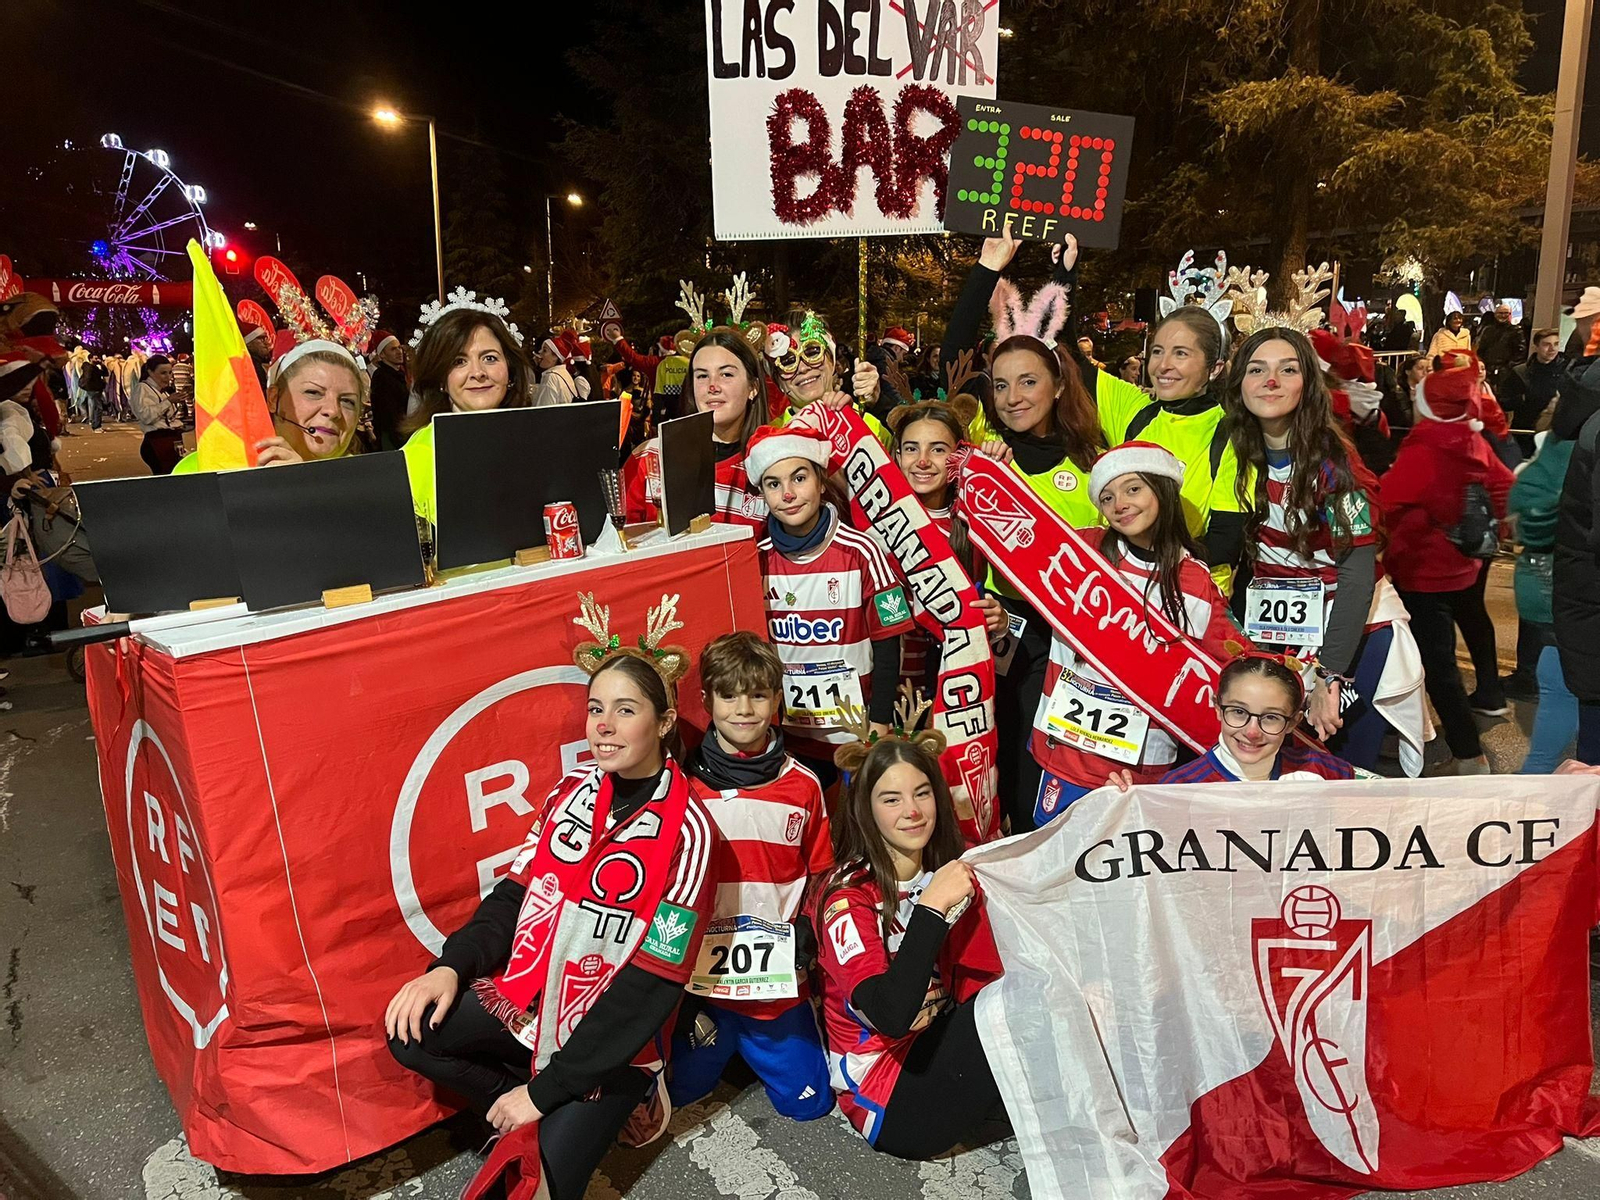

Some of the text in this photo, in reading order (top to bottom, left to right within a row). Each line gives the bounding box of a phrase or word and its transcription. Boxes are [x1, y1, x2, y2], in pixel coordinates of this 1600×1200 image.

[712, 0, 987, 86] LAS DEL VAR
[975, 104, 1002, 114] ENTRA
[1050, 114, 1072, 122] SALE
[766, 83, 962, 227] BAR
[845, 448, 987, 737] GRANADA CF
[1258, 599, 1308, 624] 203
[770, 613, 843, 643] wiber
[1061, 668, 1075, 682] 32
[789, 683, 840, 708] 211
[1063, 698, 1128, 739] 212
[1074, 826, 1445, 883] GRANADA
[708, 942, 775, 975] 207
